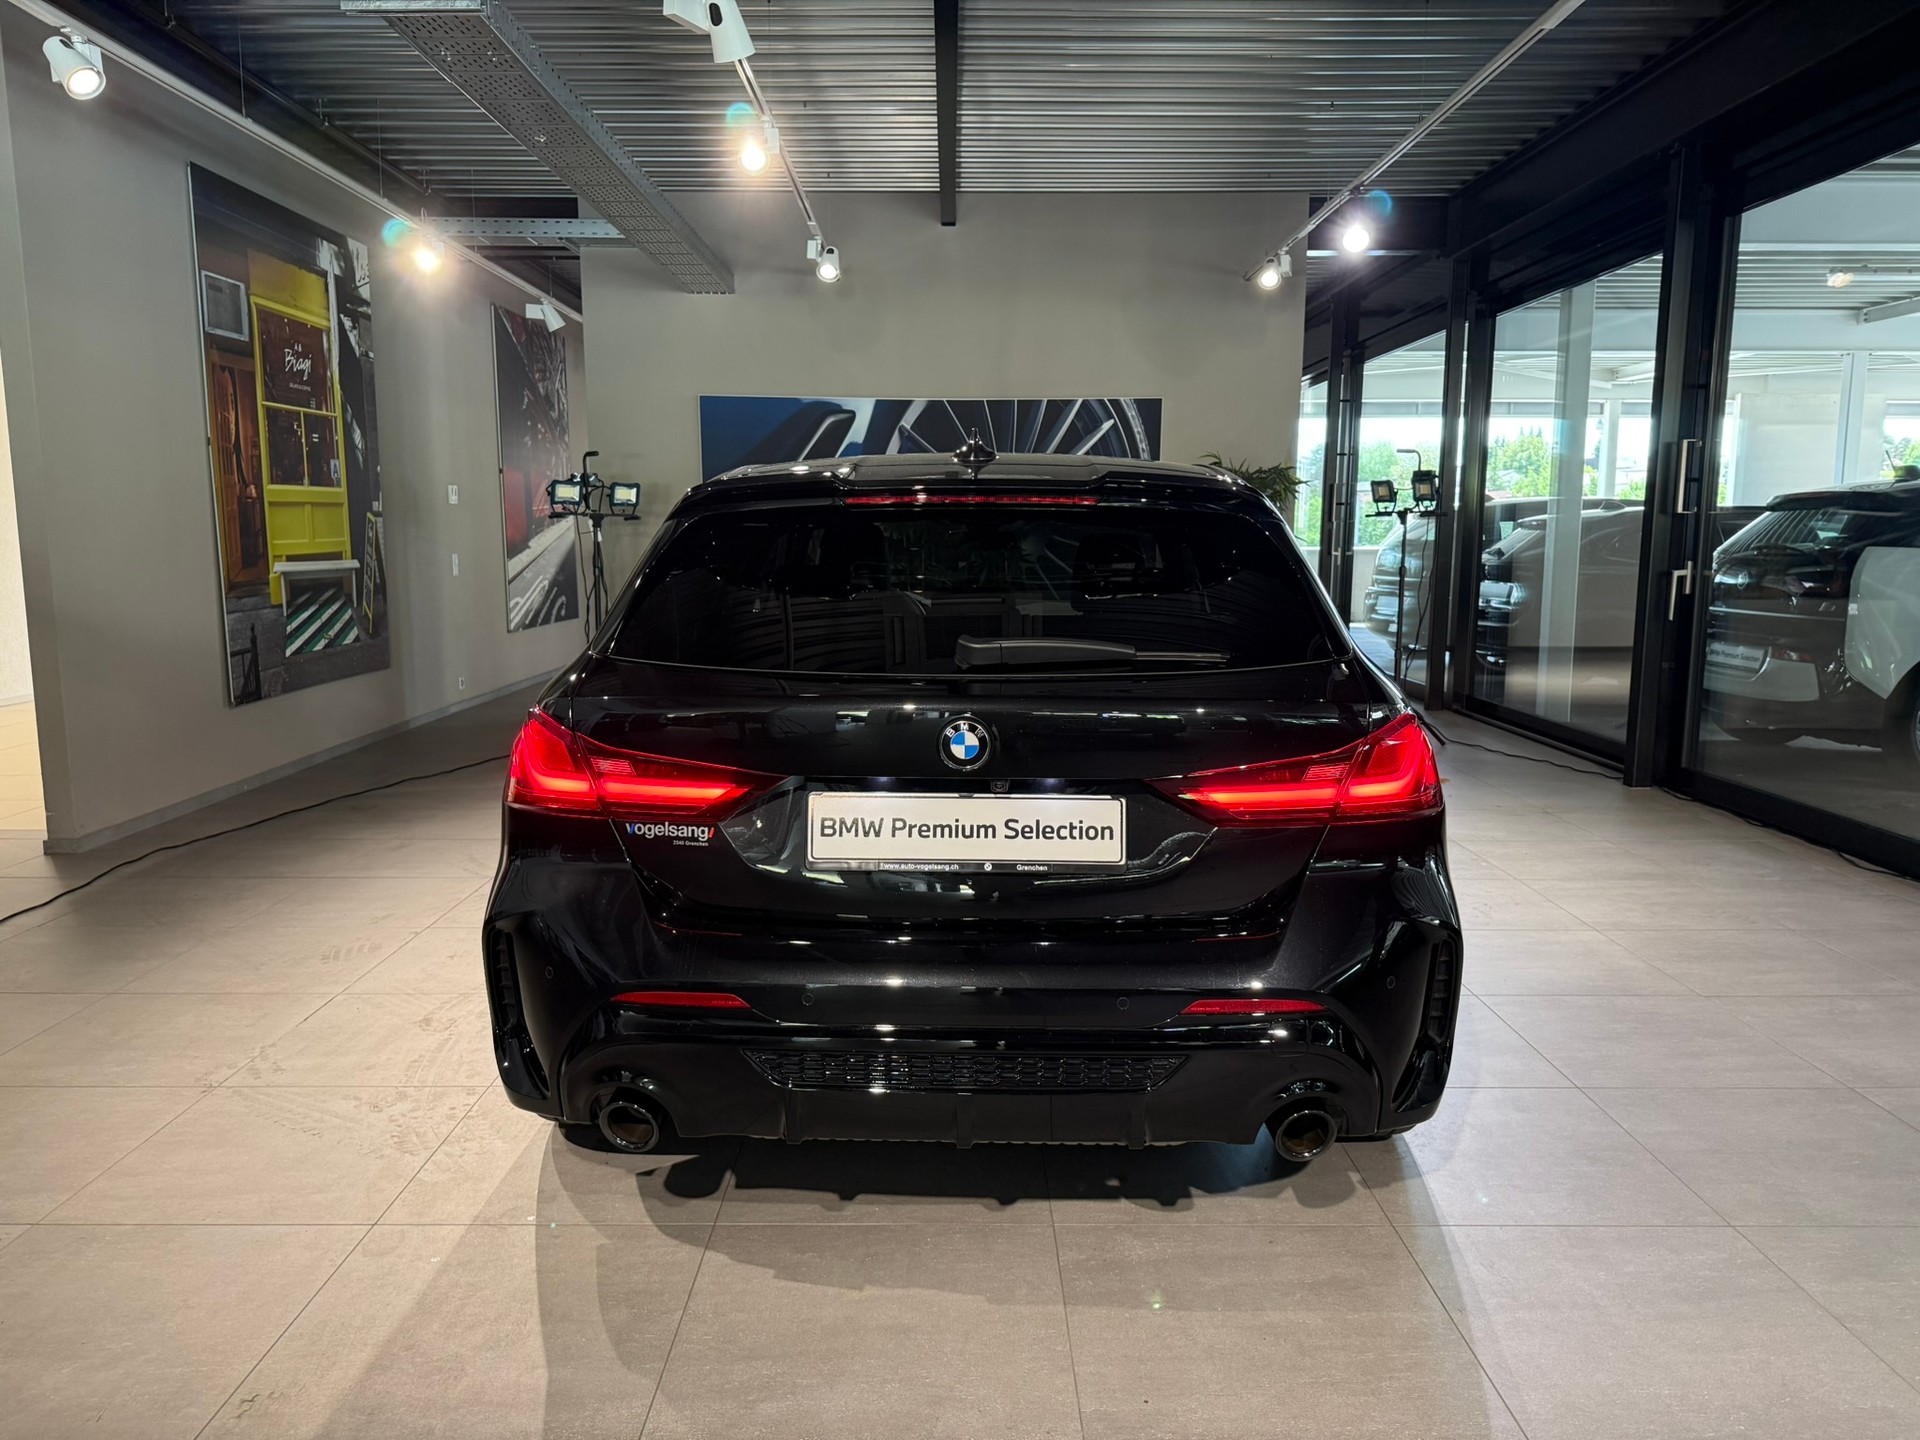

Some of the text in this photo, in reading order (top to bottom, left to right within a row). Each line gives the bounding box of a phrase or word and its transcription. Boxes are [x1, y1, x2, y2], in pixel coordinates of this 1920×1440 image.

[284, 348, 312, 381] Biagi
[945, 721, 985, 738] BMW
[819, 817, 1115, 841] BMW Premium Selection
